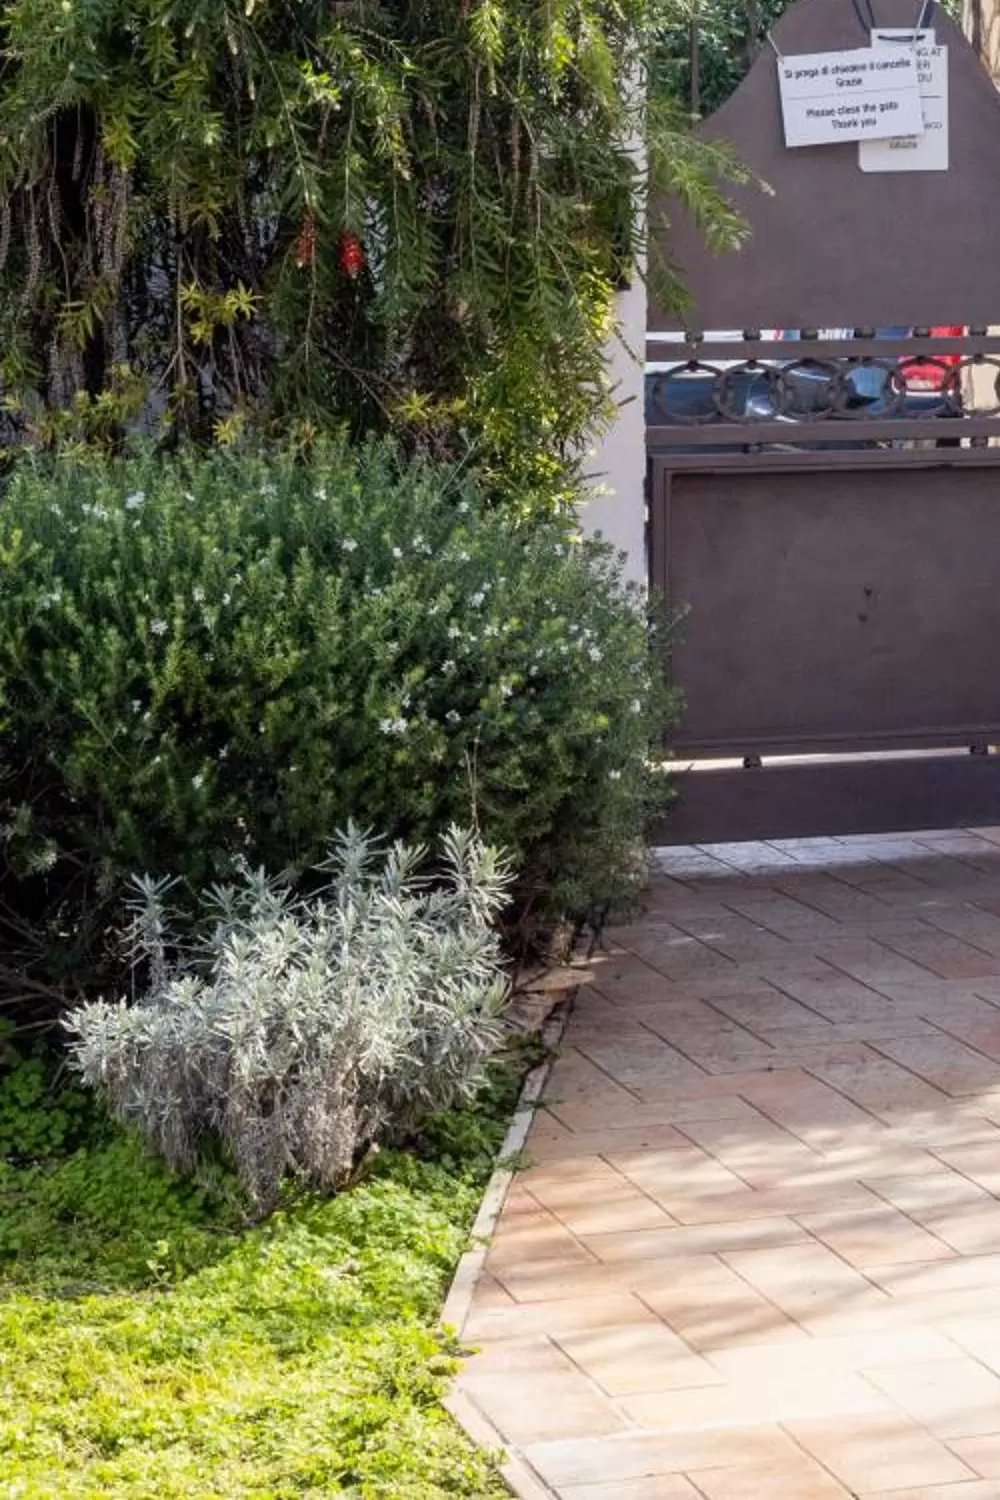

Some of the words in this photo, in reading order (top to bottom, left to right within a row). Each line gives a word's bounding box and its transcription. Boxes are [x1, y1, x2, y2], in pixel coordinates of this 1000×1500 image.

[795, 67, 819, 80] prega
[835, 77, 863, 88] Grazie
[806, 107, 834, 117] Please
[837, 104, 861, 115] close
[863, 102, 877, 112] the
[879, 101, 898, 112] gate
[831, 118, 859, 129] Thank
[860, 116, 877, 129] you
